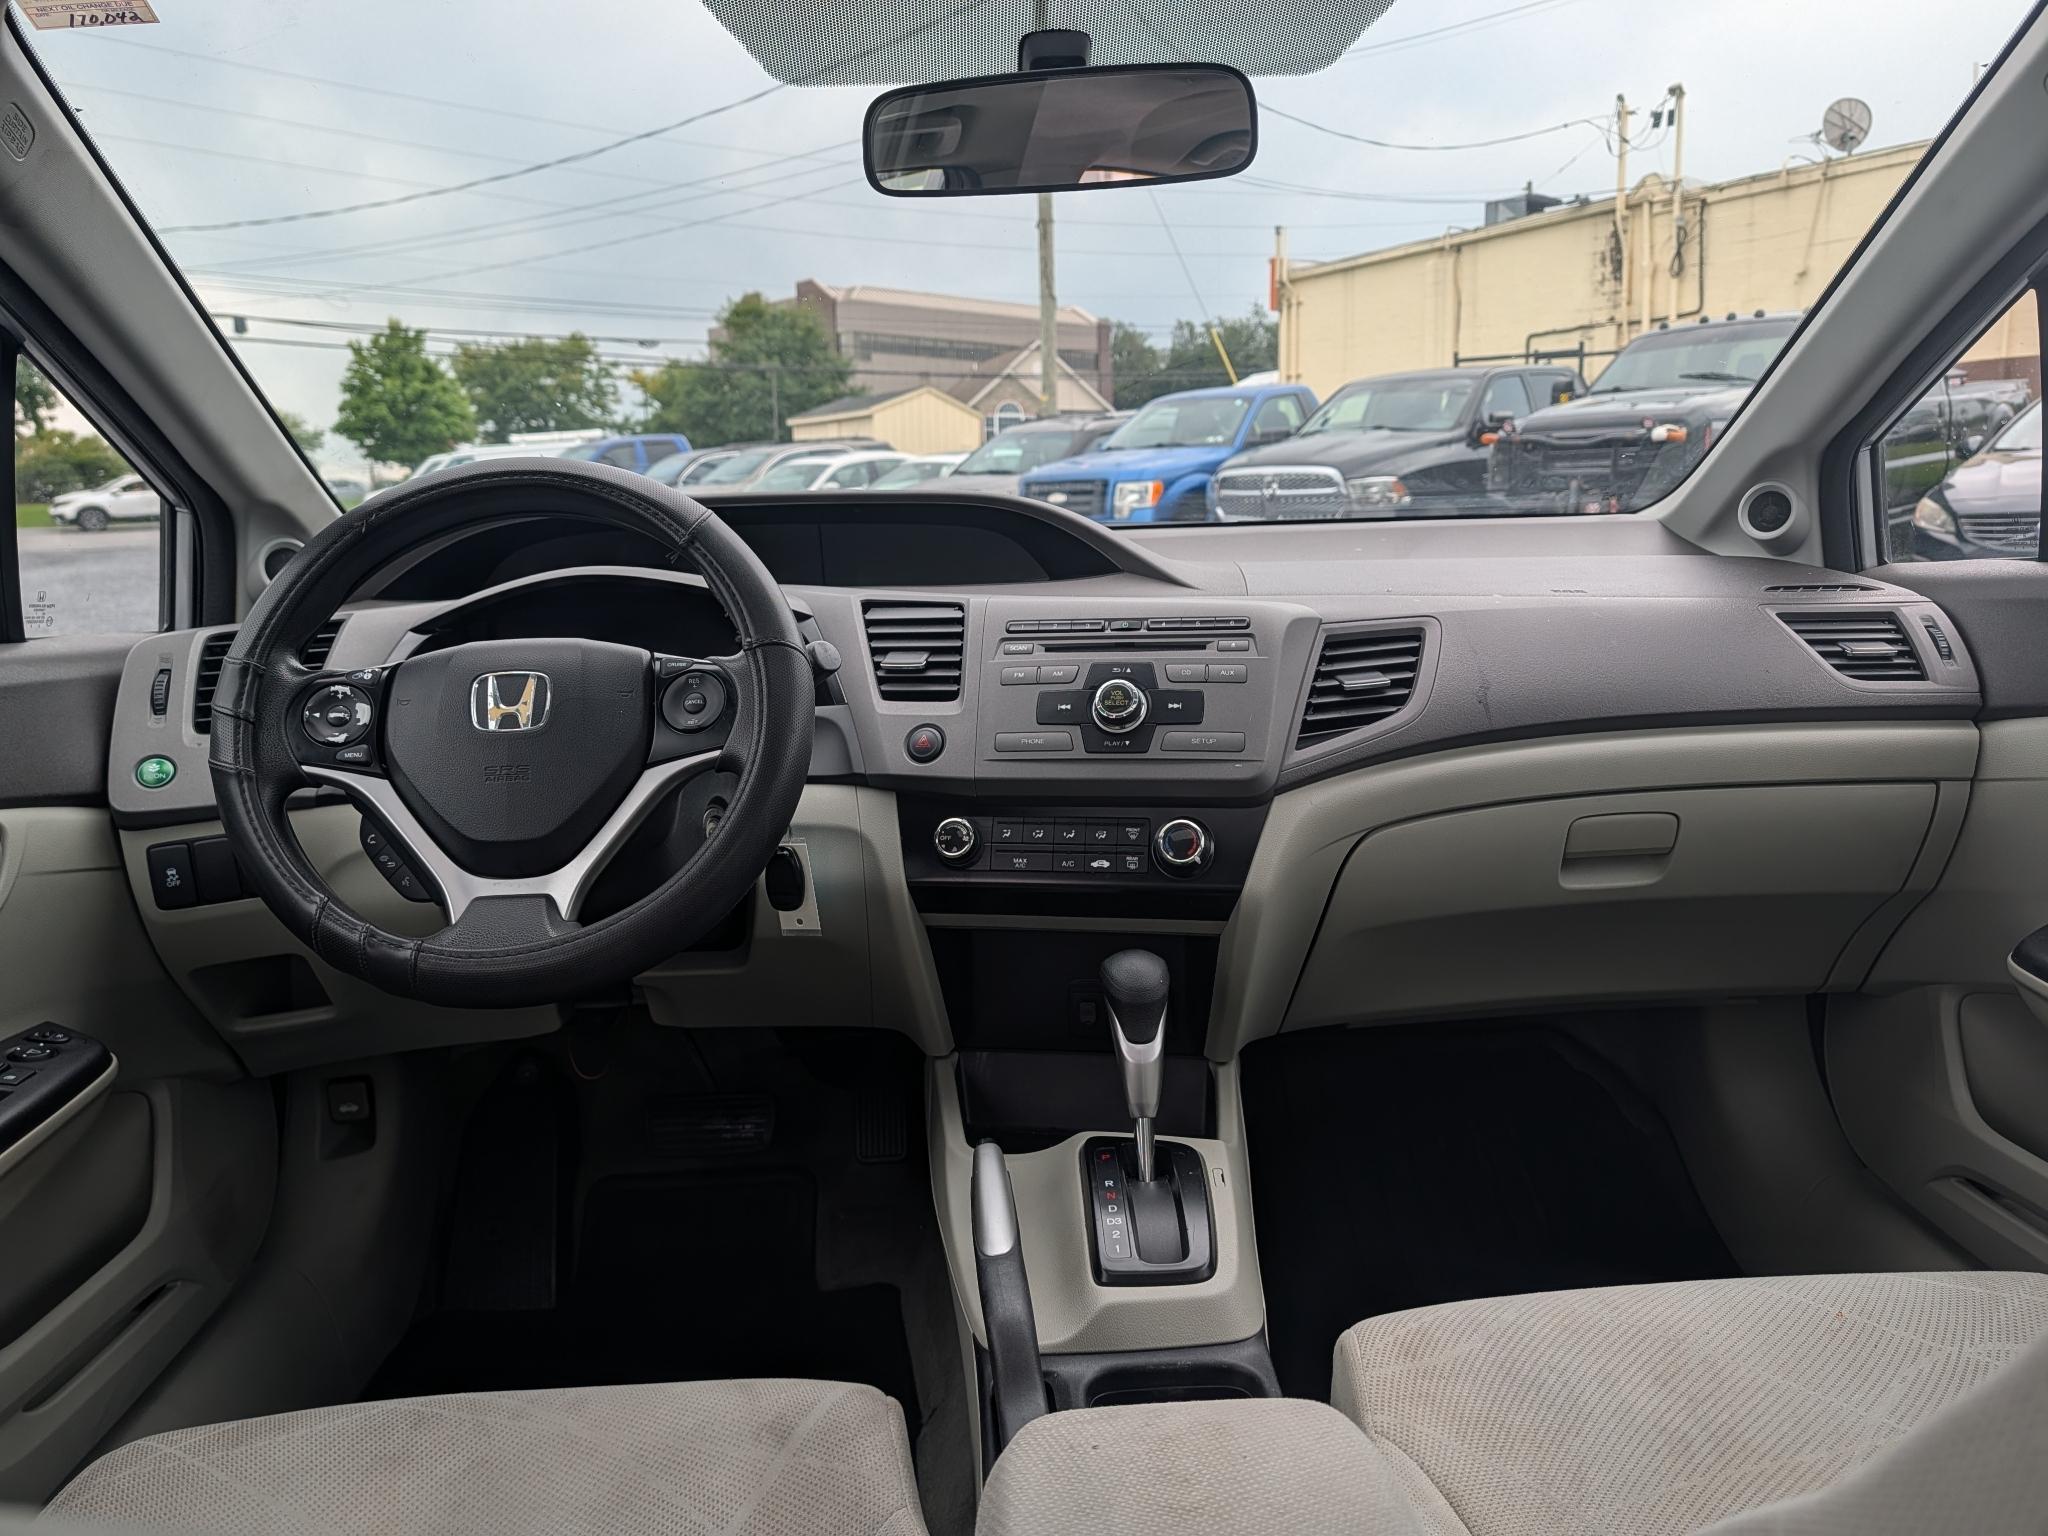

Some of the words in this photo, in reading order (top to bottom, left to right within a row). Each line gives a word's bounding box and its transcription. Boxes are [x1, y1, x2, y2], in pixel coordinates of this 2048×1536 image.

[77, 2, 114, 10] CHANGE
[12, 112, 27, 132] SIDE
[484, 764, 530, 776] SRS
[1105, 1180, 1114, 1188] R
[1106, 1192, 1116, 1200] N
[1108, 1204, 1118, 1213] D
[1106, 1217, 1122, 1226] D3
[1111, 1230, 1121, 1239] 2
[1115, 1244, 1120, 1253] 1
